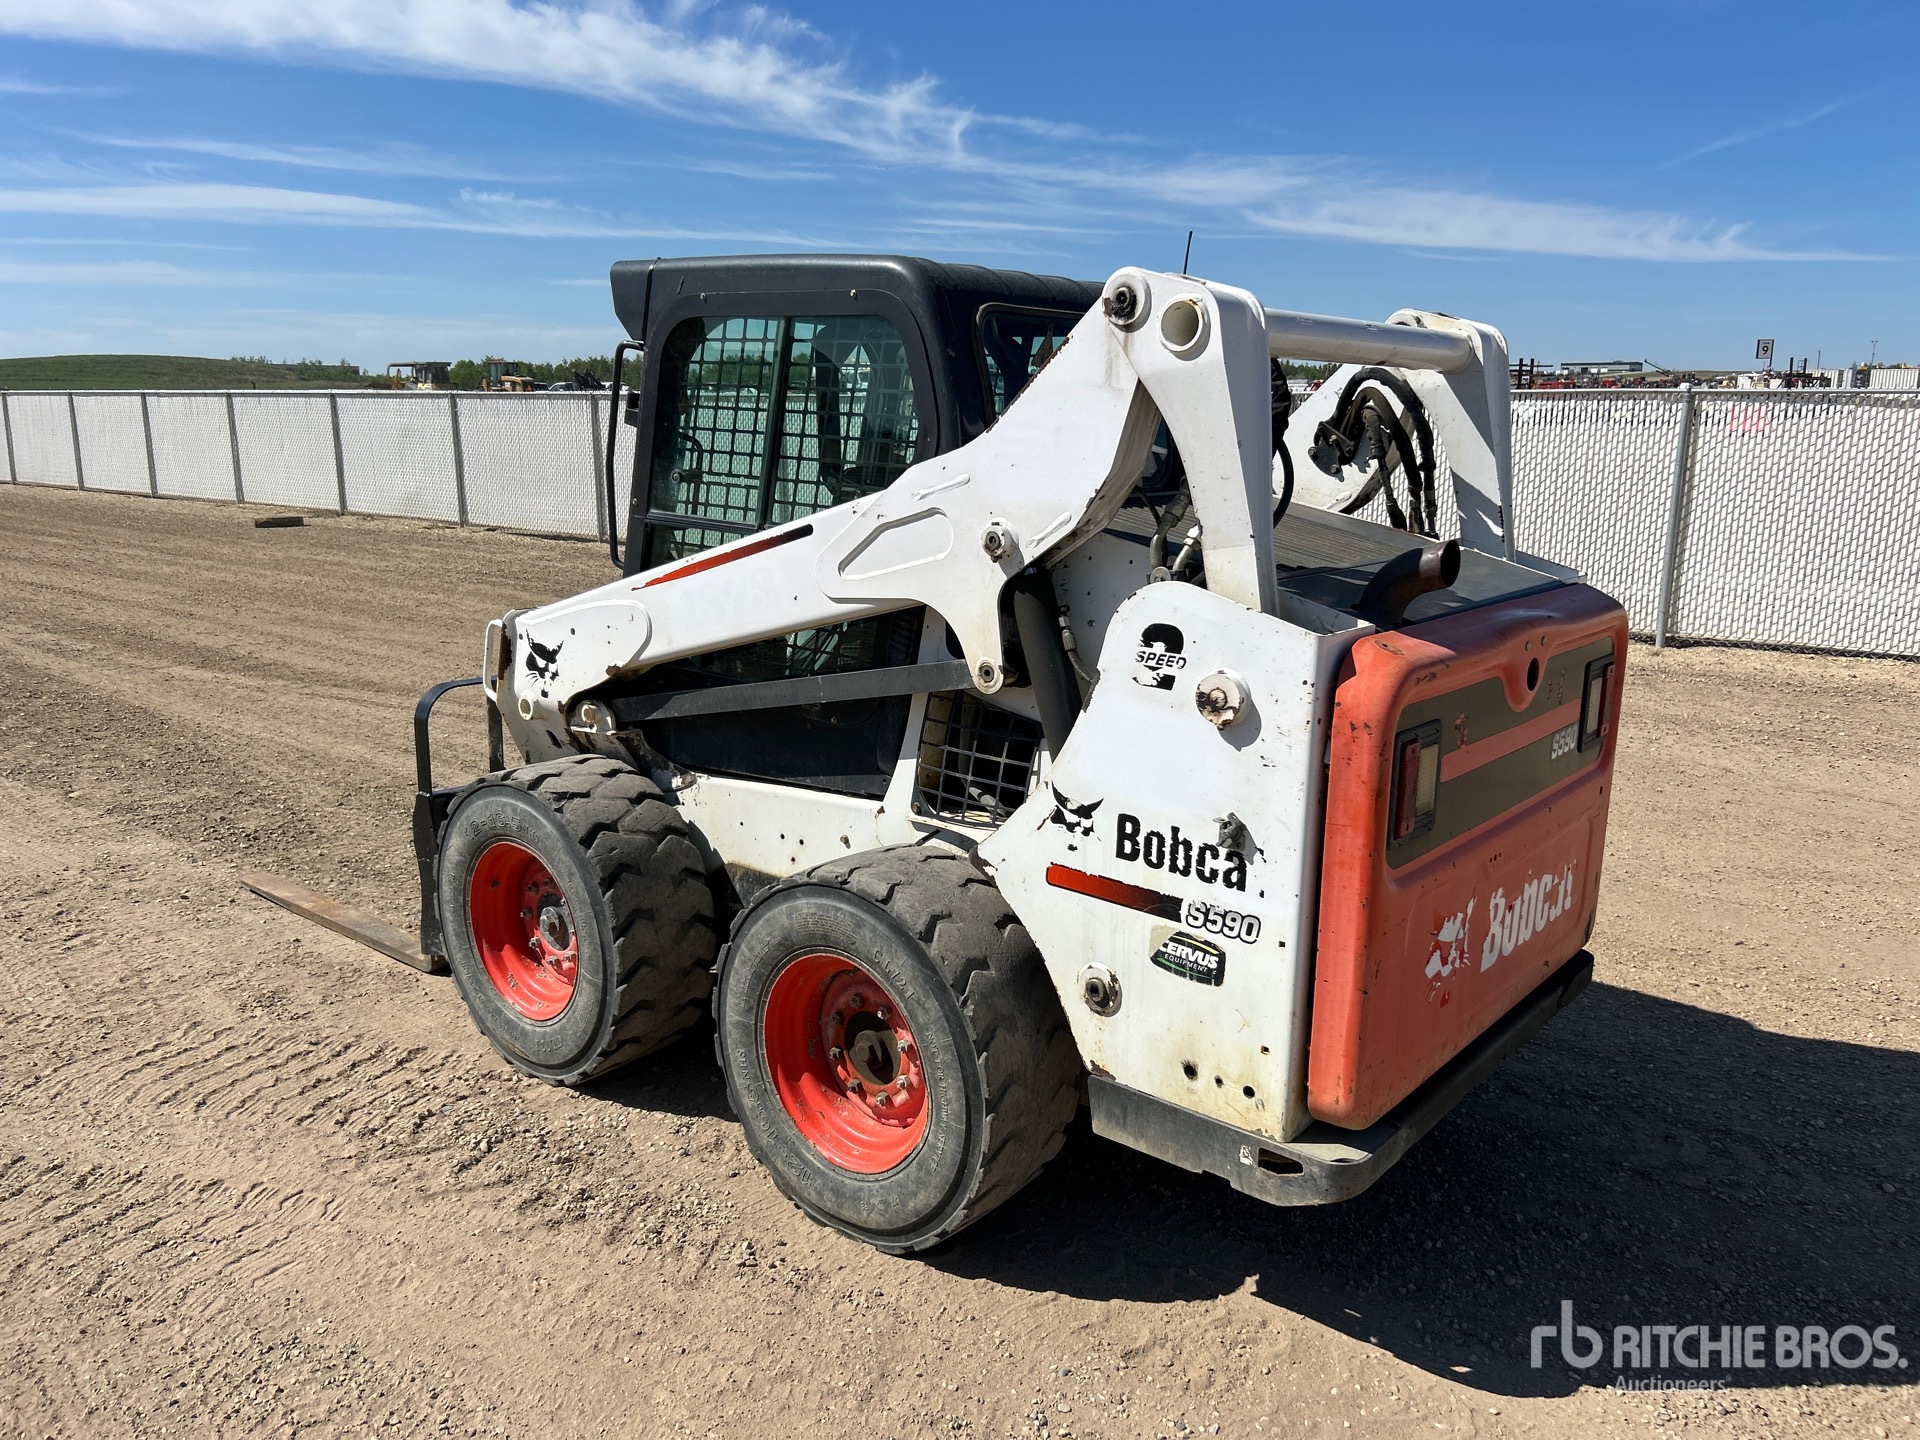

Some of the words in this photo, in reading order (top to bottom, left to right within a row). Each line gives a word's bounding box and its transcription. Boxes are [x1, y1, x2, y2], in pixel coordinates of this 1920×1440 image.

[1762, 345, 1769, 355] 9
[1135, 649, 1187, 670] SPEED
[1551, 724, 1578, 760] S590
[1115, 813, 1266, 898] Bobca
[1184, 900, 1261, 945] S590
[1159, 939, 1219, 969] CERVUS
[1164, 953, 1208, 973] EQUIPMENT
